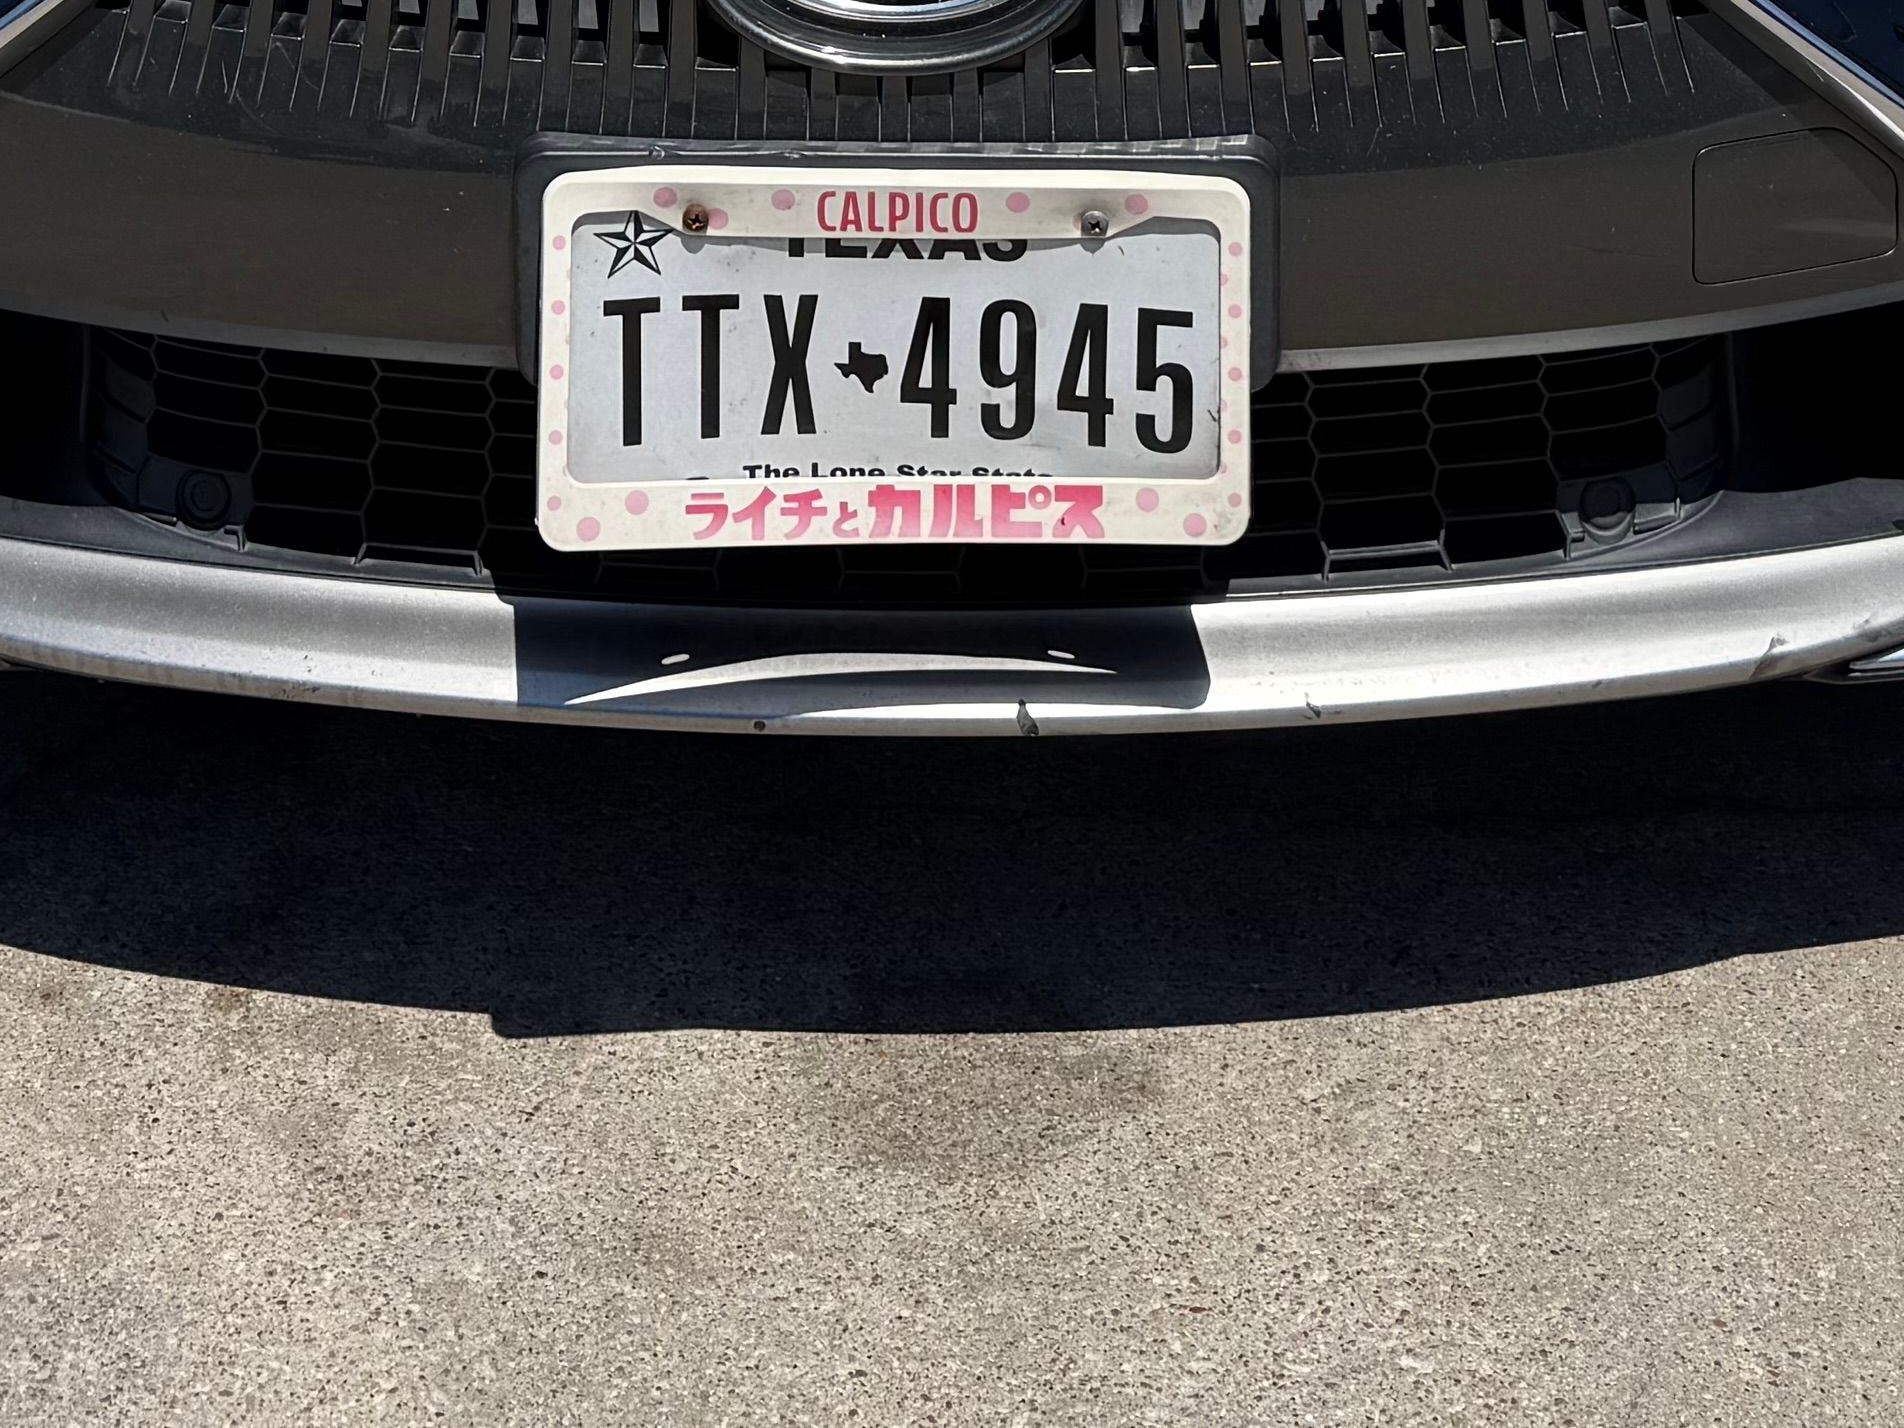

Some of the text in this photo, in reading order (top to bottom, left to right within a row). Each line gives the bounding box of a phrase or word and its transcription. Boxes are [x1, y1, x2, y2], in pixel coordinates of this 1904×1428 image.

[816, 190, 980, 234] CALPICO
[684, 483, 1105, 542] ライチとカルピス
